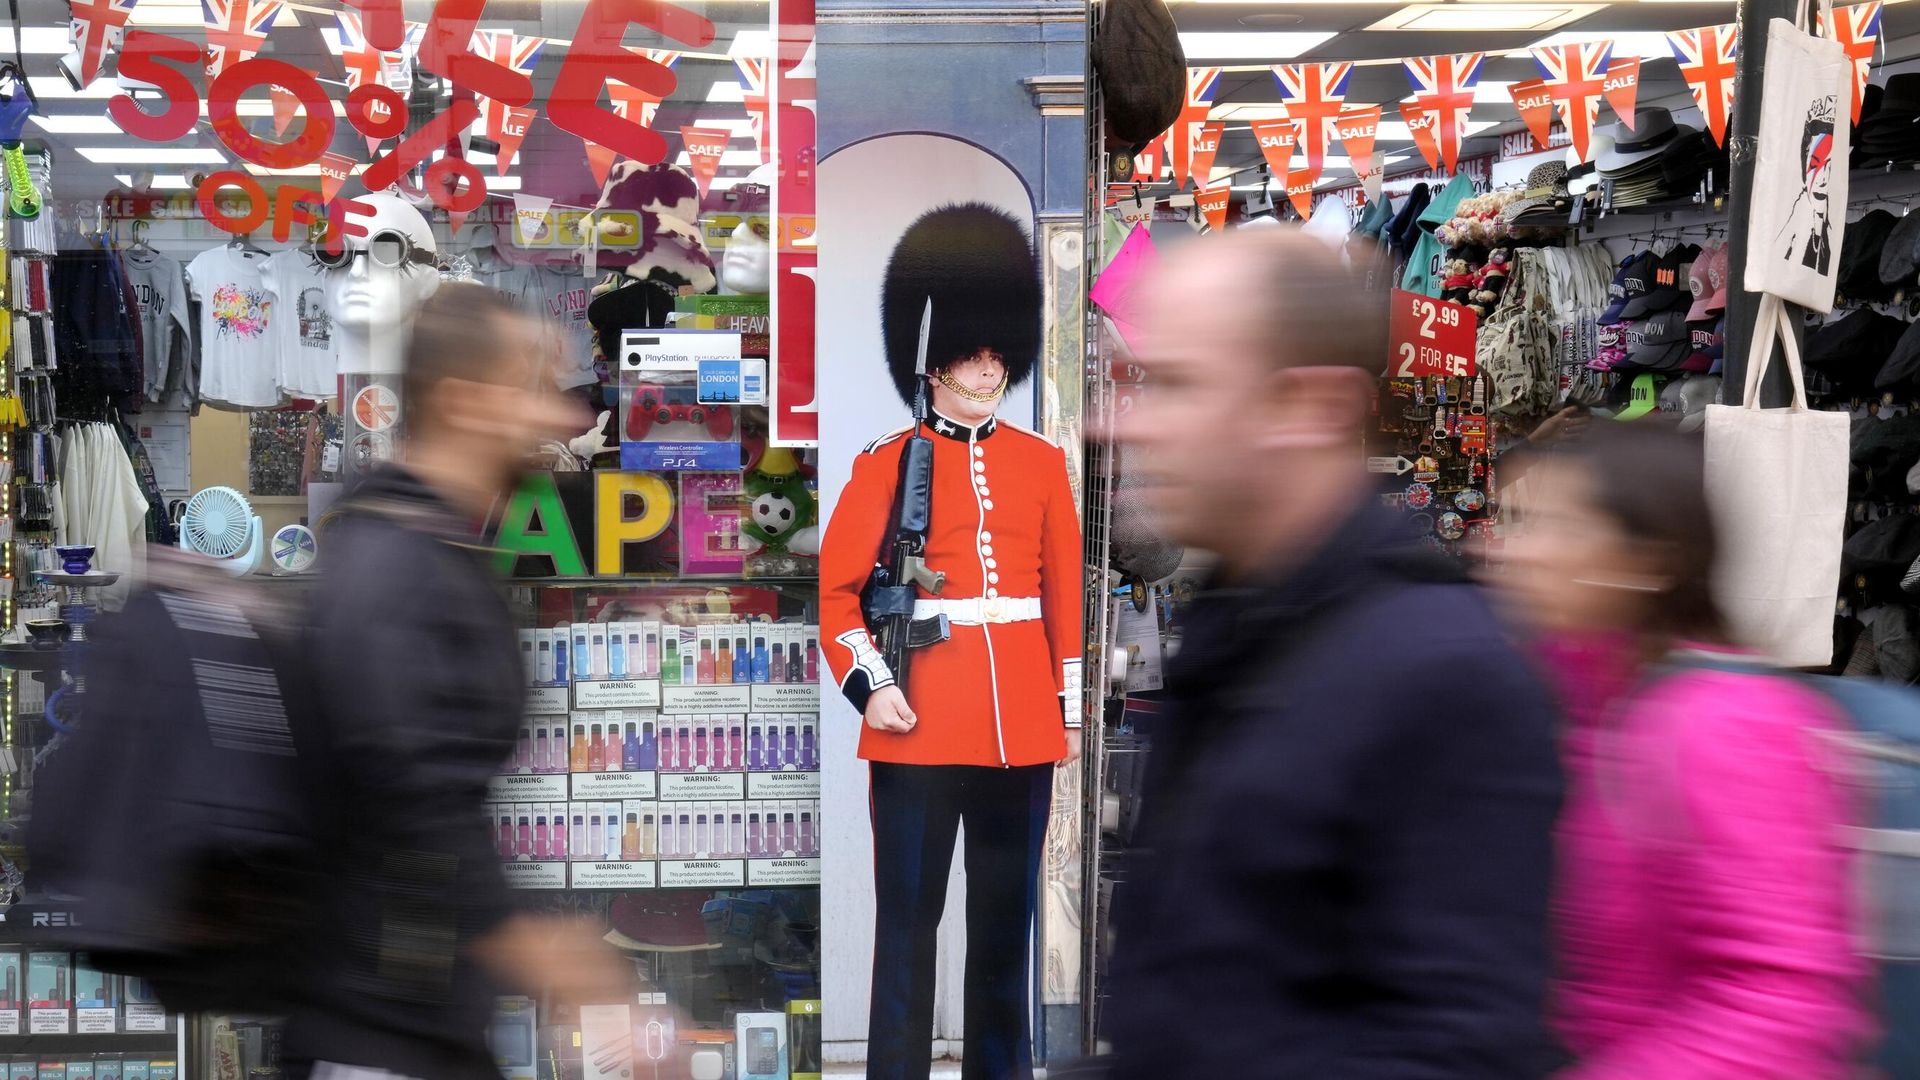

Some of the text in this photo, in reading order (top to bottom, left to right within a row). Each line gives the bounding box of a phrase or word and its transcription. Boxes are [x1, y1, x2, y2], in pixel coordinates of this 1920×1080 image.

[1602, 75, 1635, 92] SALE
[1517, 95, 1551, 111] SALE
[108, 30, 487, 212] 50%
[501, 124, 524, 137] ALE
[1341, 126, 1374, 139] SALE
[1194, 141, 1216, 152] ALE
[1261, 135, 1294, 148] SALE
[1505, 132, 1533, 157] SALE
[689, 143, 722, 157] SALE
[321, 167, 347, 181] SALE
[1287, 184, 1312, 196] SALE
[198, 171, 377, 256] OFF
[1201, 201, 1227, 213] SALE
[518, 209, 543, 220] SALE
[132, 284, 165, 315] NDON
[548, 288, 588, 317] LOND
[1412, 299, 1459, 339] £2.99
[1397, 342, 1468, 378] 2 FOR £5
[701, 375, 738, 383] LONDON
[662, 458, 697, 468] PS4
[491, 469, 745, 578] APE
[33, 912, 83, 927] REL
